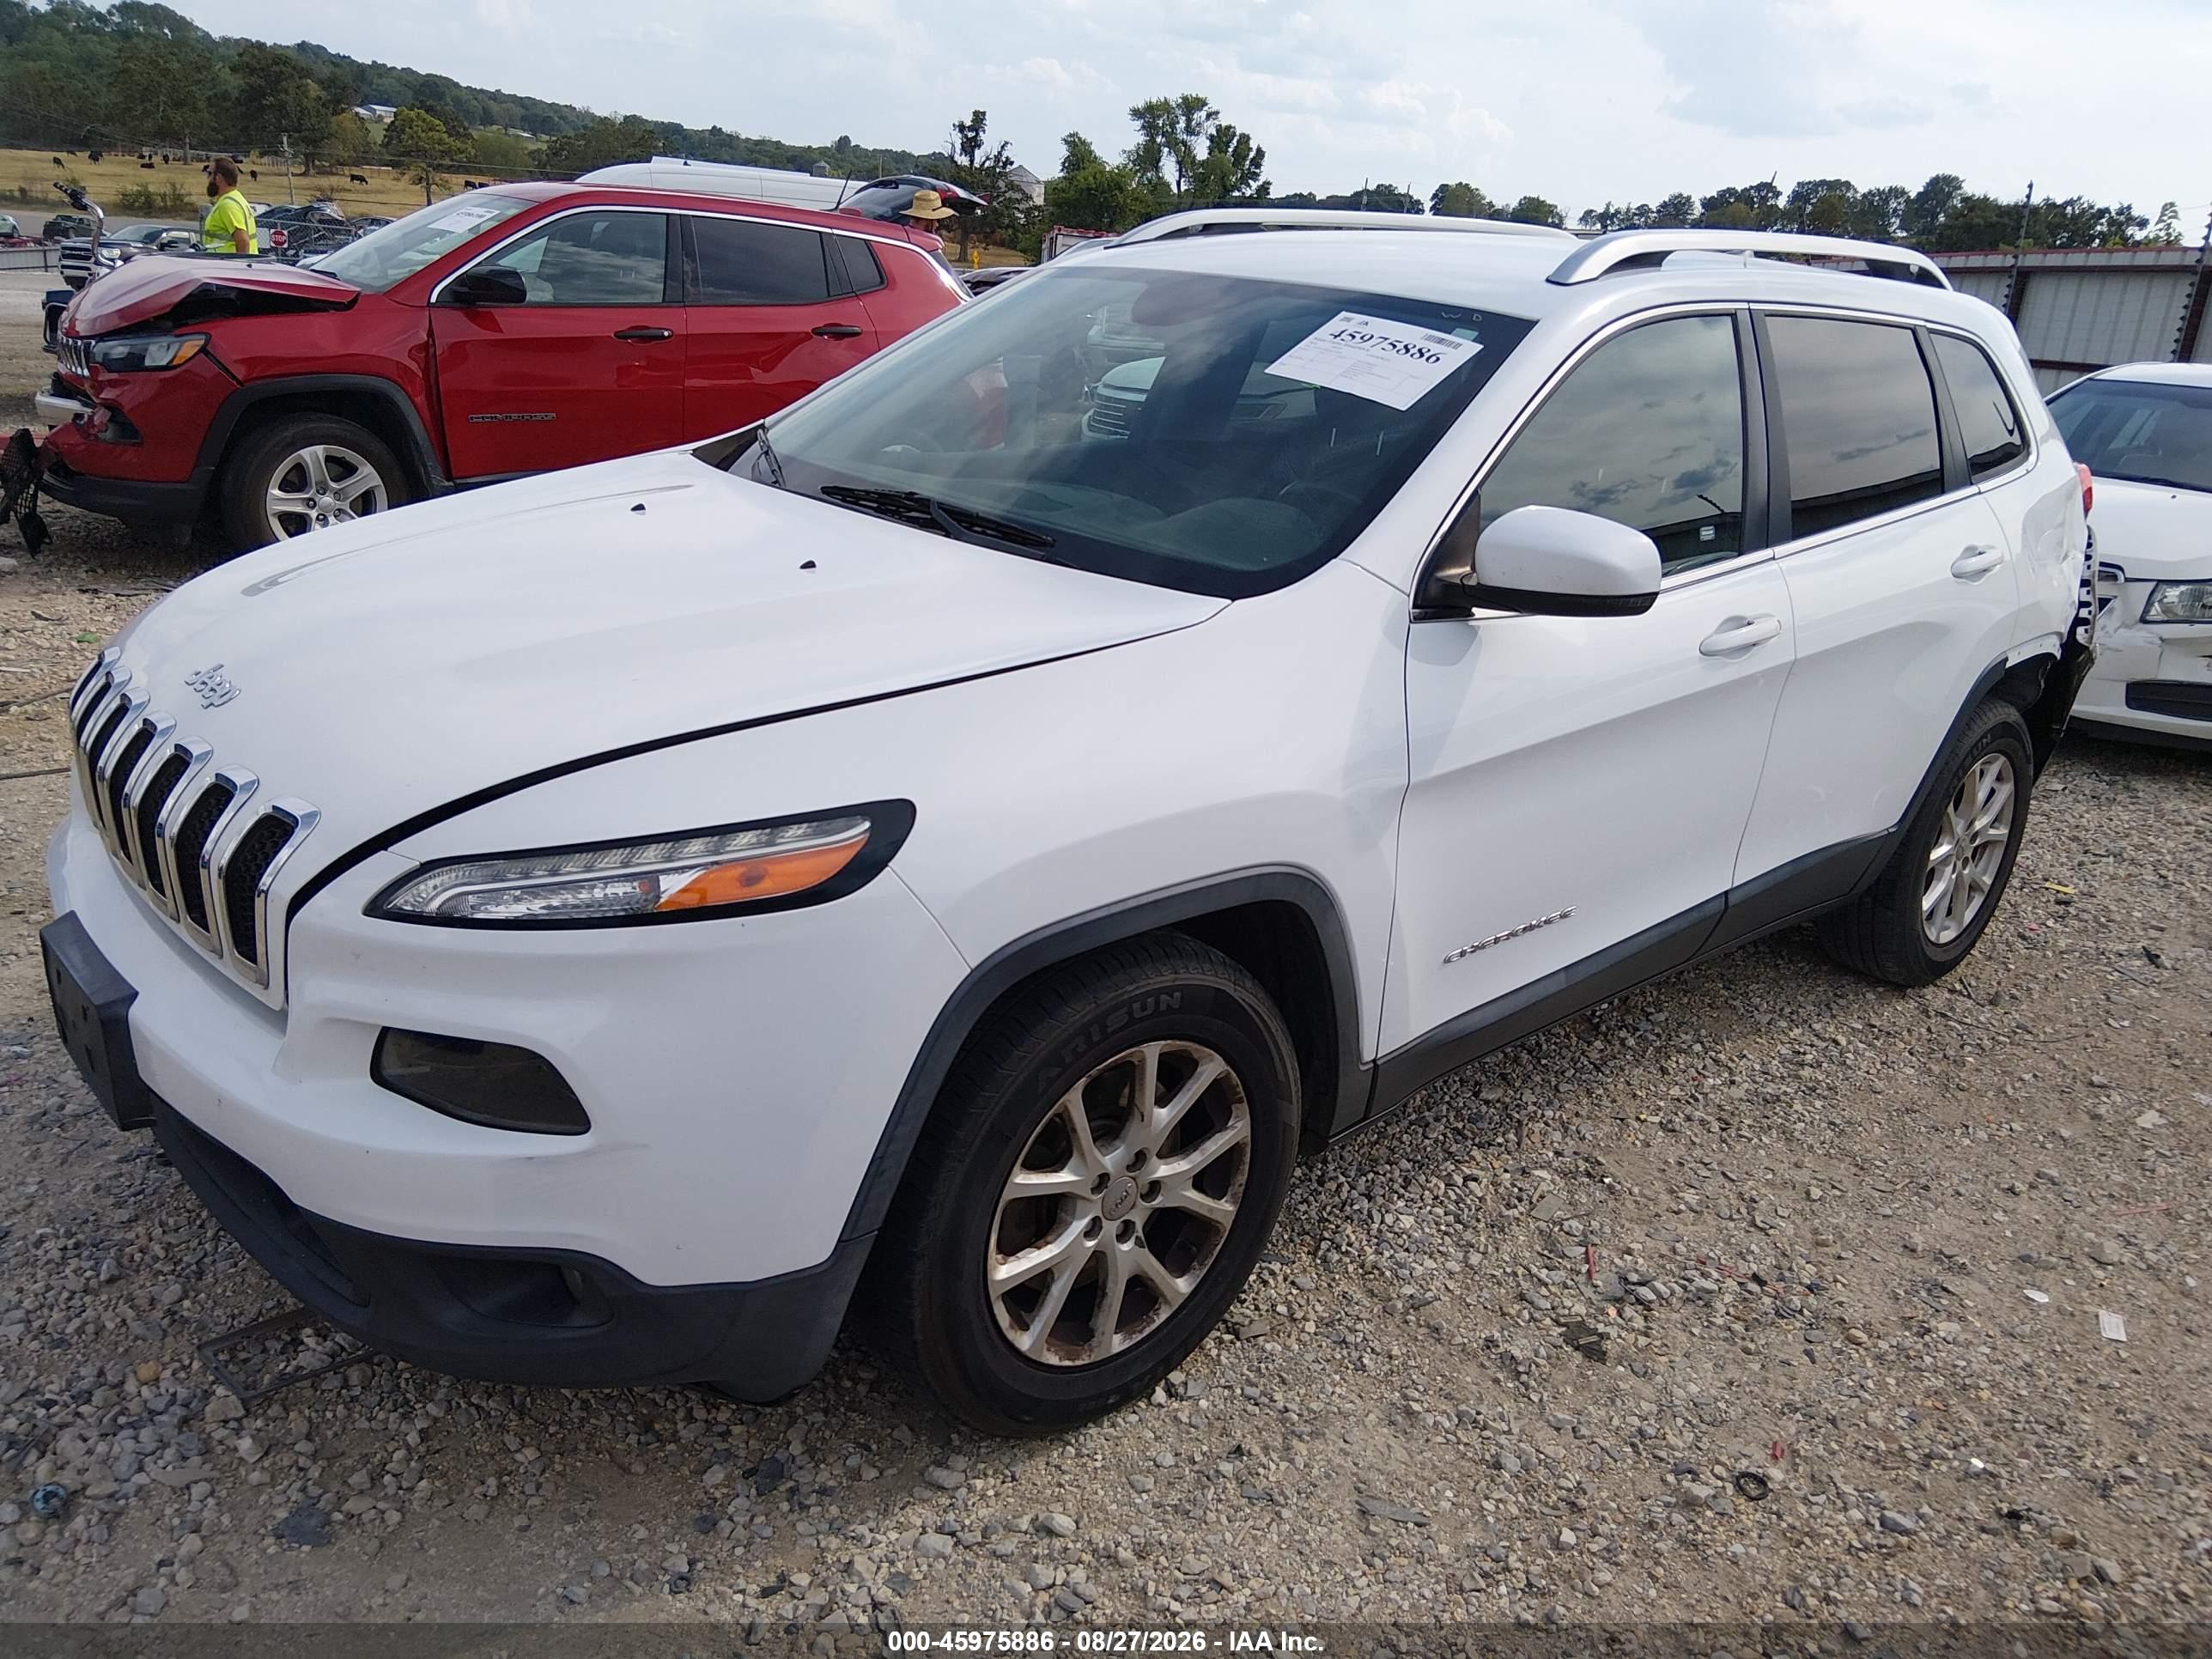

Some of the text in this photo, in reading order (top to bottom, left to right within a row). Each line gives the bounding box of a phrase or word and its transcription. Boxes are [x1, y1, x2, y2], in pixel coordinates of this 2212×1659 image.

[270, 234, 287, 242] STOP
[1329, 328, 1448, 365] 45975886
[468, 413, 556, 422] COMPASS
